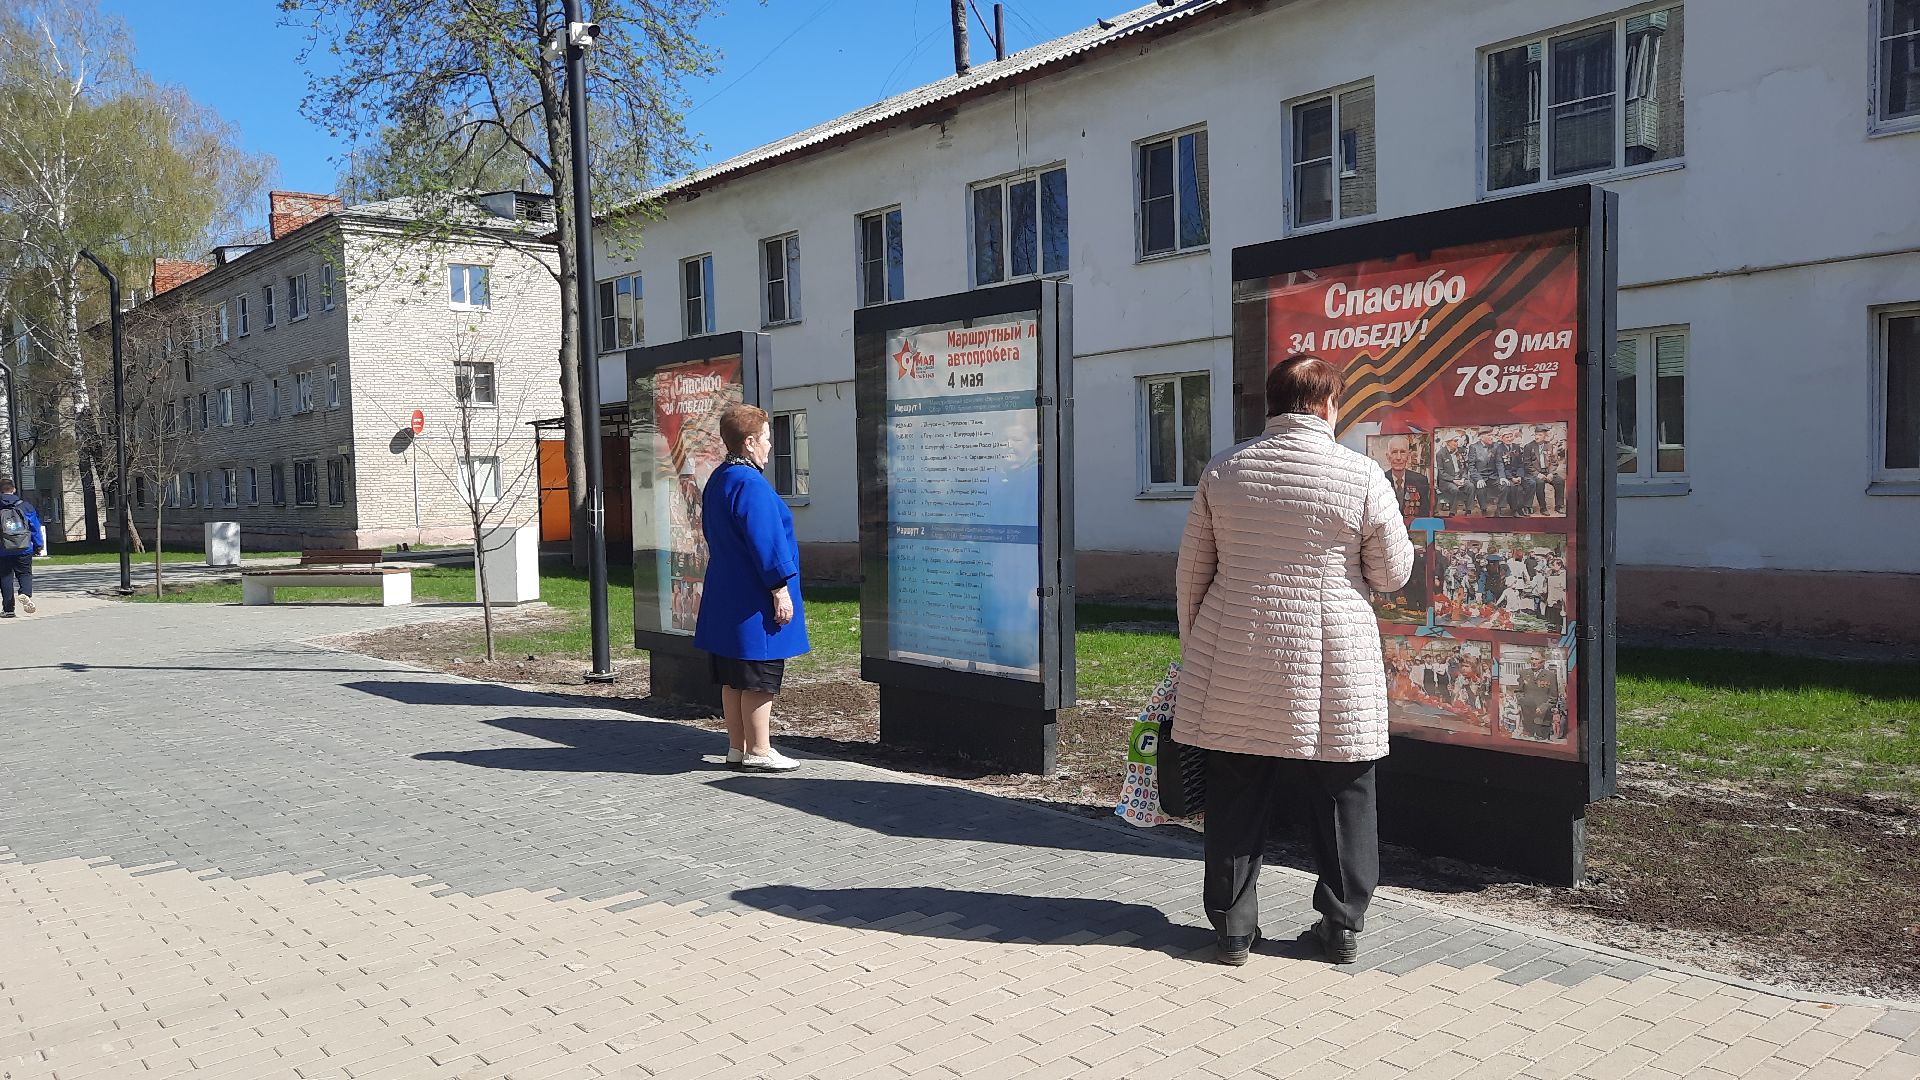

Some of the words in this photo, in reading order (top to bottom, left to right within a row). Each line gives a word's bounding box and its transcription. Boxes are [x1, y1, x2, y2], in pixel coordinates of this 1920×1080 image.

[1324, 269, 1466, 319] Спасибо
[947, 322, 1022, 349] Маршрутный
[1287, 333, 1315, 354] ЗА
[1322, 318, 1429, 351] ПОБЕДУ!
[1493, 328, 1519, 360] 9
[1520, 330, 1573, 353] МАЯ
[947, 345, 1020, 368] автопробега
[674, 371, 722, 396] Спасибо
[947, 371, 956, 389] 4
[960, 372, 984, 388] мая
[1140, 735, 1155, 751] F
